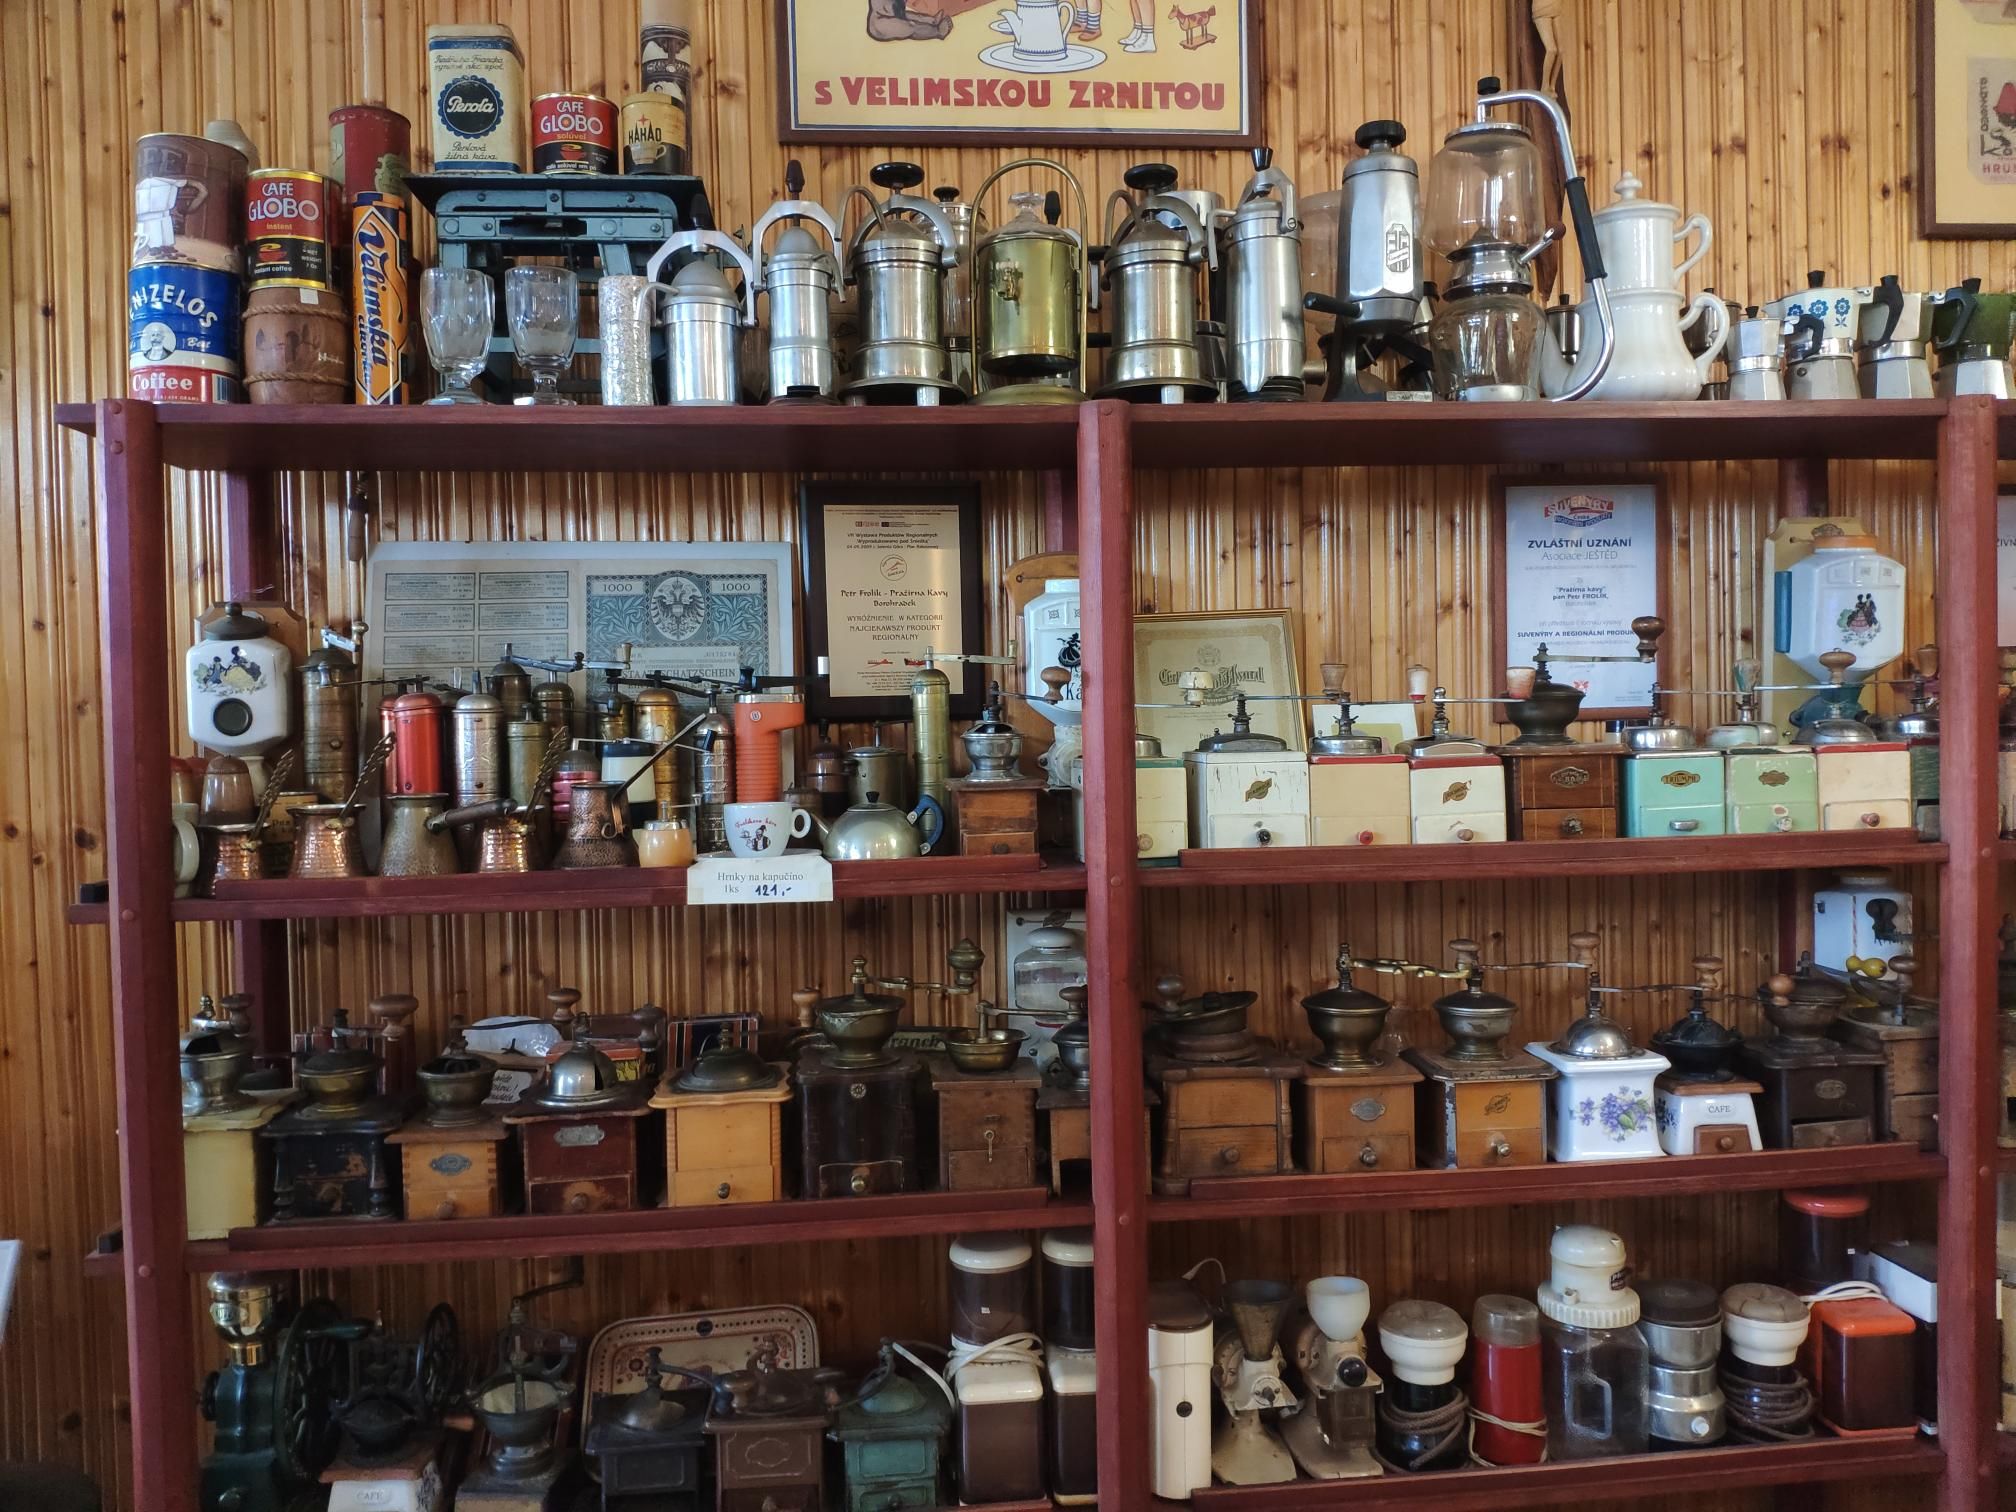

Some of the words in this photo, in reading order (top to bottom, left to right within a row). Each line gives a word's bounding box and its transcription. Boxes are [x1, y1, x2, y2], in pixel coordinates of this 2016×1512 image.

[815, 80, 832, 105] S
[840, 75, 1051, 107] VELIMSKOU
[1068, 79, 1225, 110] ZRNITOU
[446, 95, 495, 113] Perola
[557, 99, 584, 113] CAFÉ
[540, 113, 604, 135] GLOBO
[262, 180, 294, 197] CAFÉ
[248, 197, 320, 222] GLOBO
[132, 371, 193, 393] Coffee
[1527, 537, 1583, 549] ZVLÁŠTNÍ
[1586, 536, 1632, 548] UZNÁNÍ
[1541, 551, 1582, 561] Asociace
[603, 582, 633, 592] 1000
[721, 582, 751, 592] 1000
[906, 624, 941, 632] PRODUKT
[623, 668, 736, 679] STAATSCHATZSCHEIN
[718, 872, 746, 883] Hrnky
